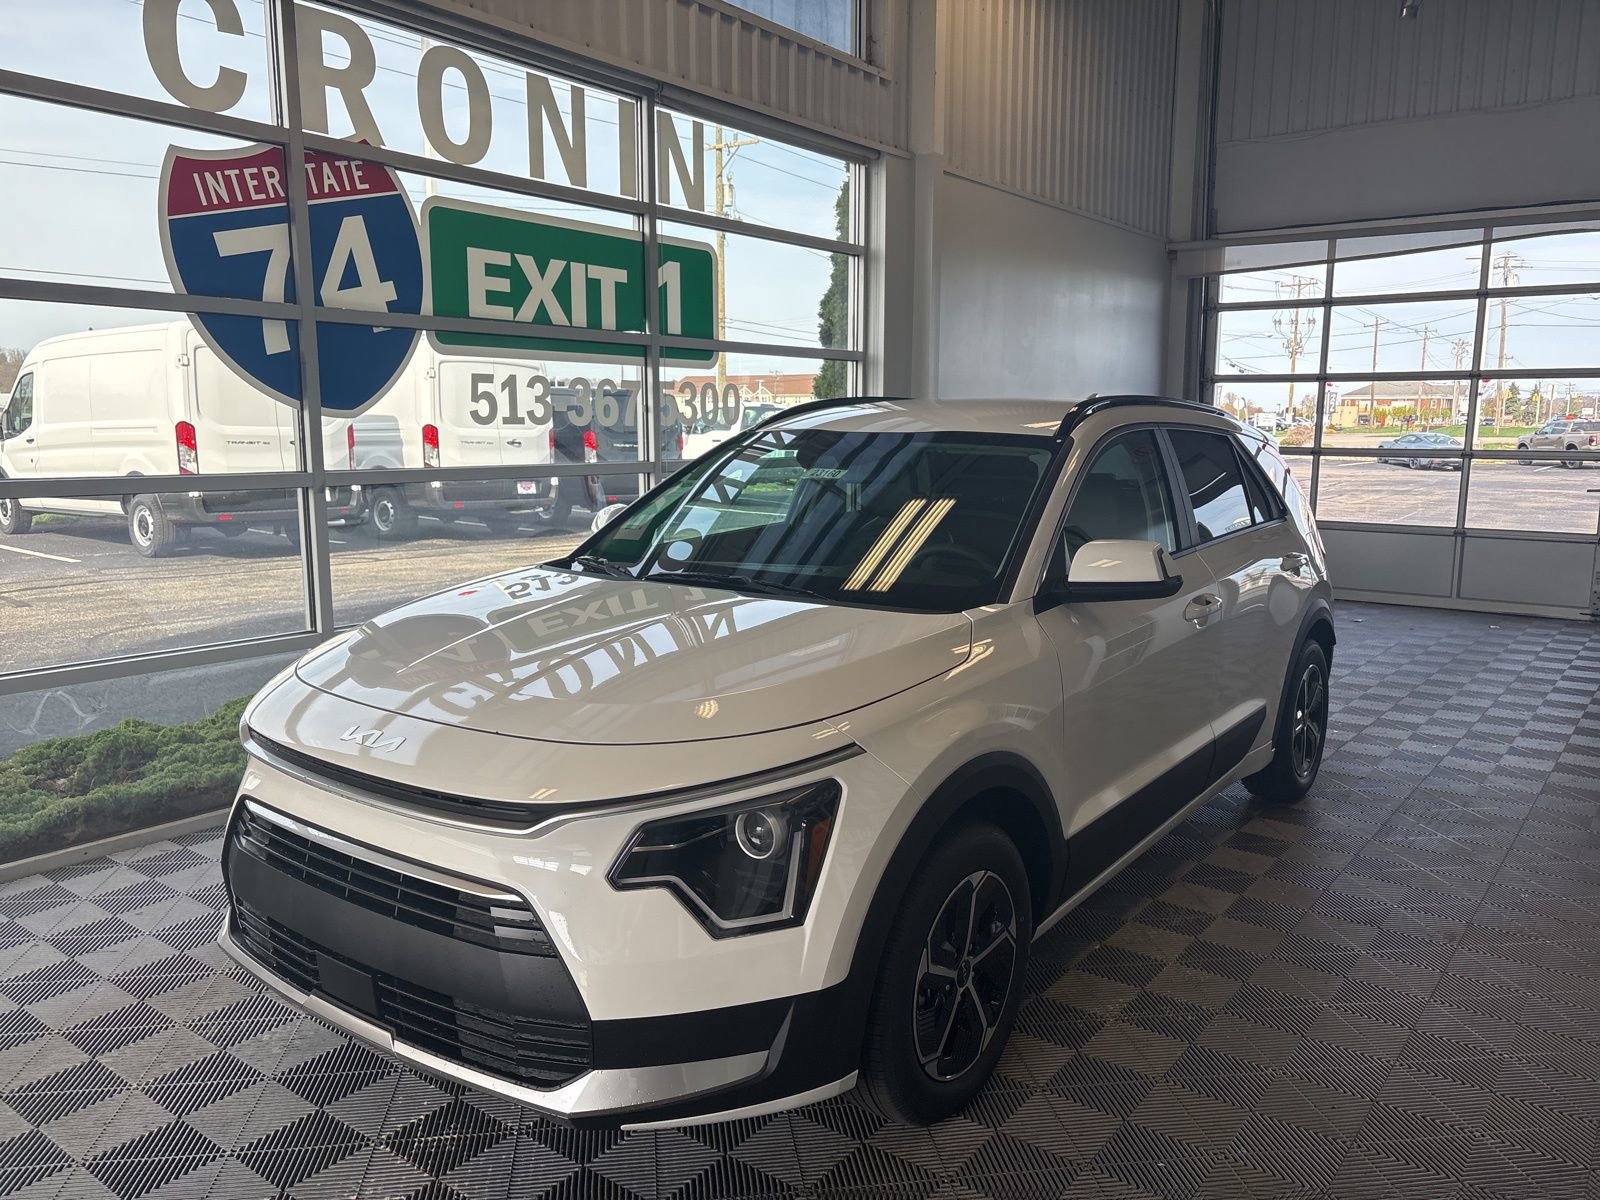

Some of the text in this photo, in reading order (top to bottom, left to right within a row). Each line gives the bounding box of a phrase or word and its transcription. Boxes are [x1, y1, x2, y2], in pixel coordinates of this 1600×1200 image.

[143, 0, 705, 212] CRONIN
[192, 160, 370, 206] INTERTATE
[212, 214, 398, 355] 74
[466, 246, 682, 335] EXIT 1
[469, 372, 741, 427] 513-3675300
[339, 725, 407, 753] KIA
